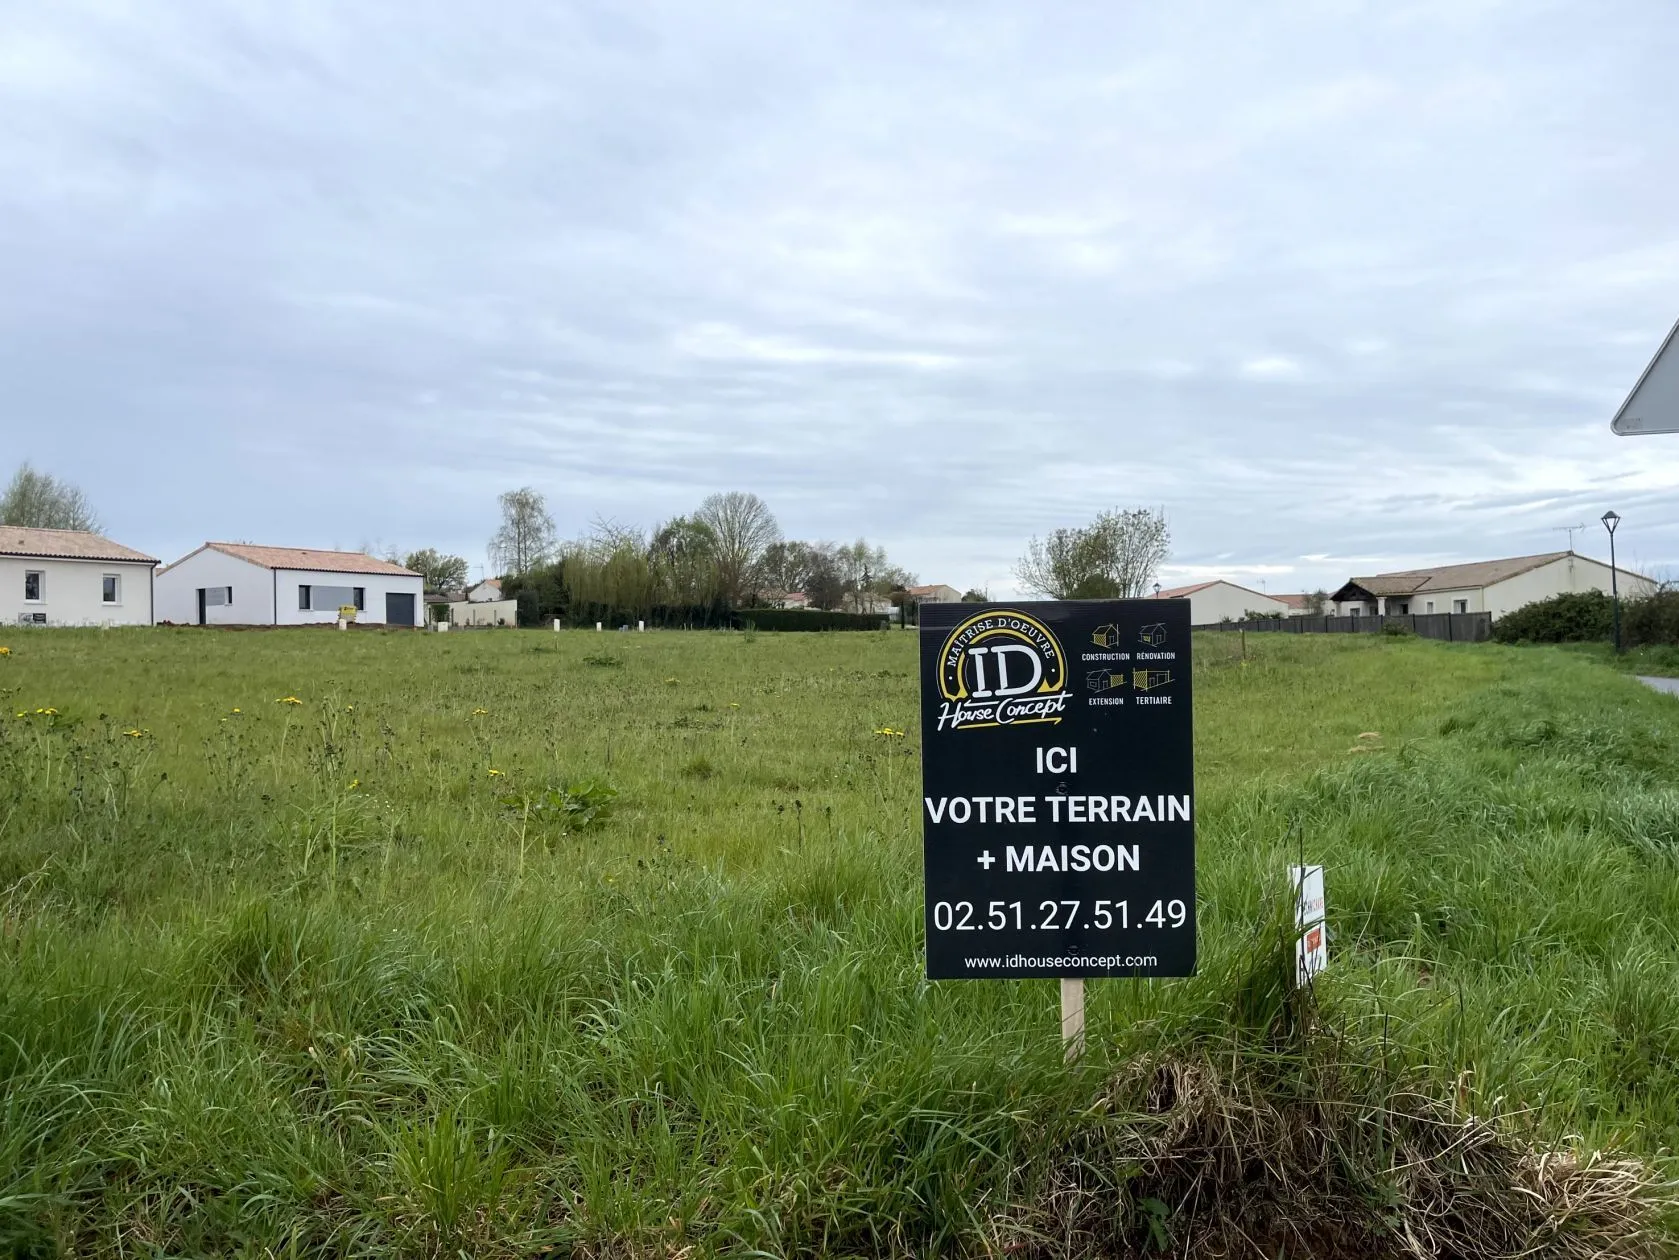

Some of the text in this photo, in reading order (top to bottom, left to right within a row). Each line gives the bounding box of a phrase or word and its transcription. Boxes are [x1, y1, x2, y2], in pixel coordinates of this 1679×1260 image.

[947, 618, 1055, 667] MAÎTRISE D'OEUVRE
[1136, 651, 1176, 660] RÉNOVATION
[1081, 652, 1130, 661] CONSTRUCTION
[968, 644, 1042, 698] ID
[937, 690, 1073, 731] House Concept
[1088, 697, 1124, 706] EXTENSION
[1135, 696, 1172, 705] TERTIAIRE
[1036, 747, 1077, 774] ICI
[925, 795, 1191, 824] VOTRE TERRAIN
[977, 844, 1140, 872] + MAISON
[933, 899, 1187, 931] 02.51.27.51.49
[964, 954, 1158, 970] www.idhouseconcept.com
